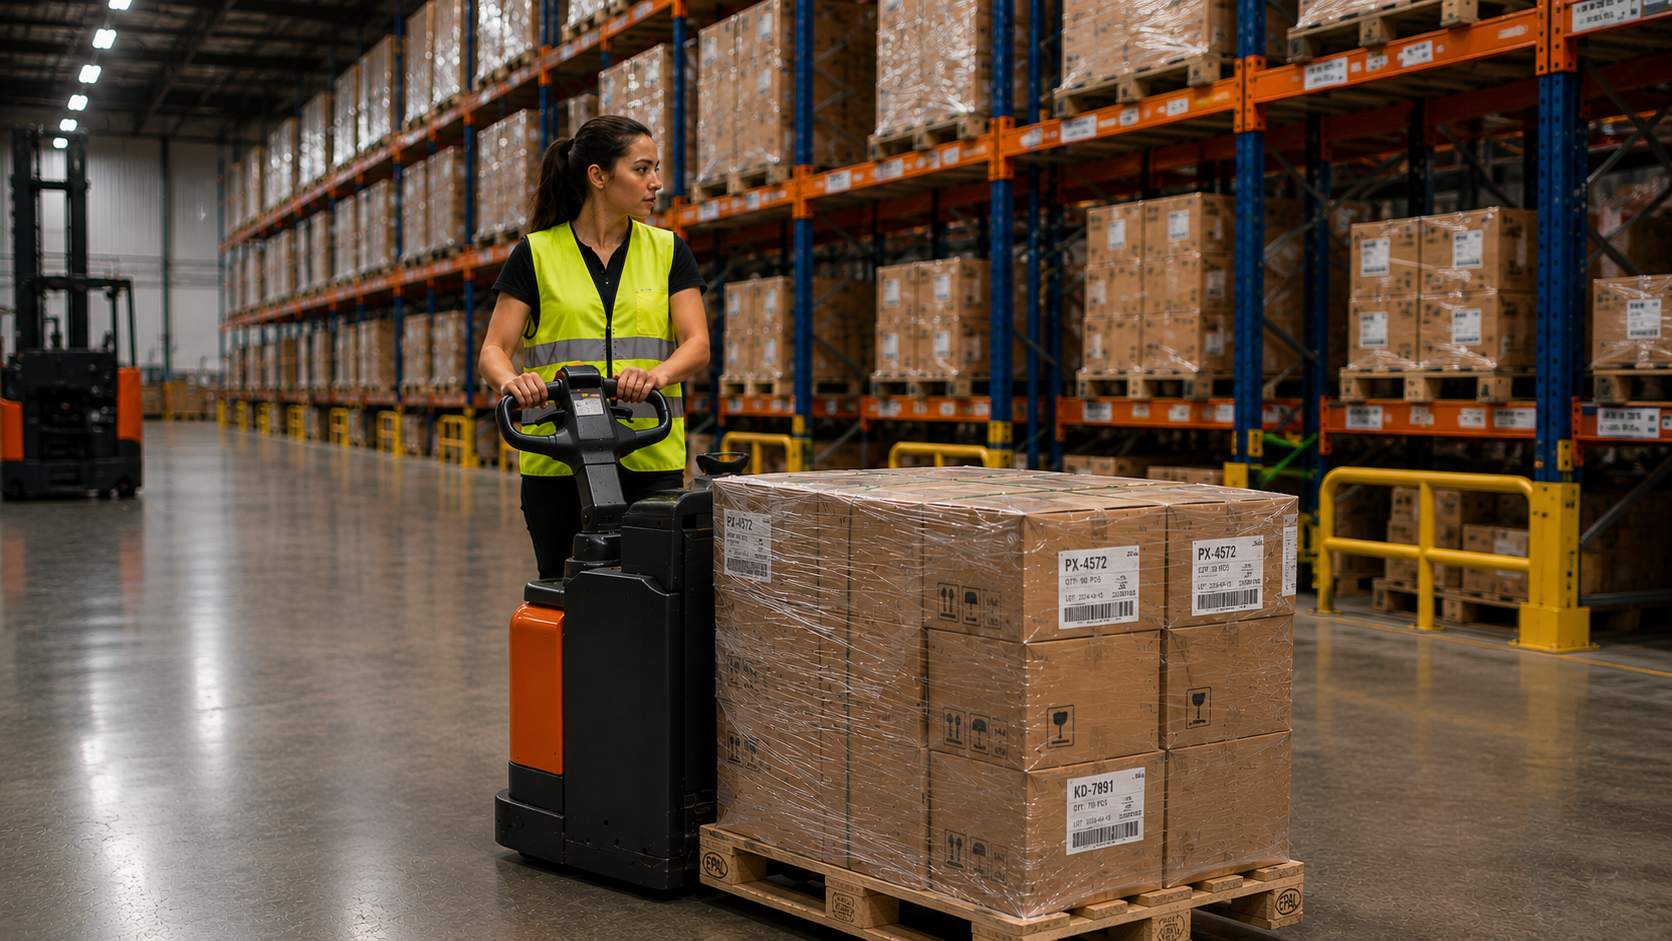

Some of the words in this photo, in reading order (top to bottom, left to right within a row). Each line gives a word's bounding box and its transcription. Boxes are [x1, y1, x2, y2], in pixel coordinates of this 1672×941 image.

[1198, 545, 1236, 560] PX-4572
[1065, 556, 1107, 572] PX-4572
[1074, 780, 1113, 799] KD-7891
[706, 856, 724, 875] EPAL
[1279, 893, 1297, 911] EPAL
